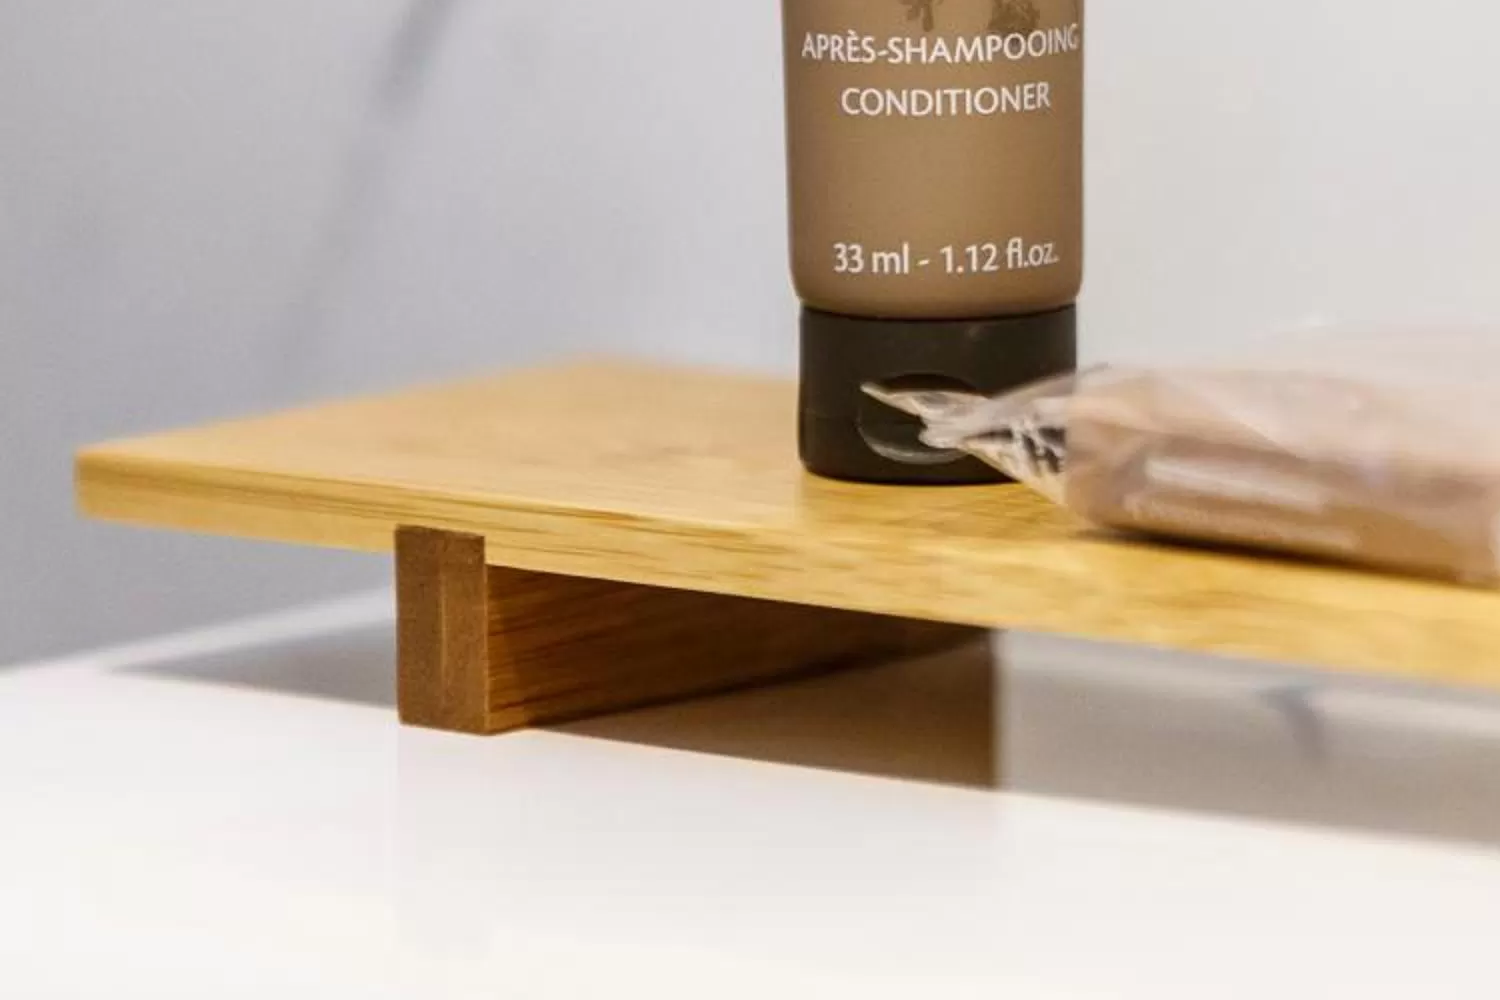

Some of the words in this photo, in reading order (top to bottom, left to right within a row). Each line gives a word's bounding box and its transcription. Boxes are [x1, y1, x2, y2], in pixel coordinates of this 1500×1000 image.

[801, 22, 1079, 65] APRÈS-SHAMPOOING
[841, 81, 1051, 117] CONDITIONER
[833, 242, 865, 274] 33
[871, 241, 910, 275] ml
[940, 242, 1000, 274] 1.12
